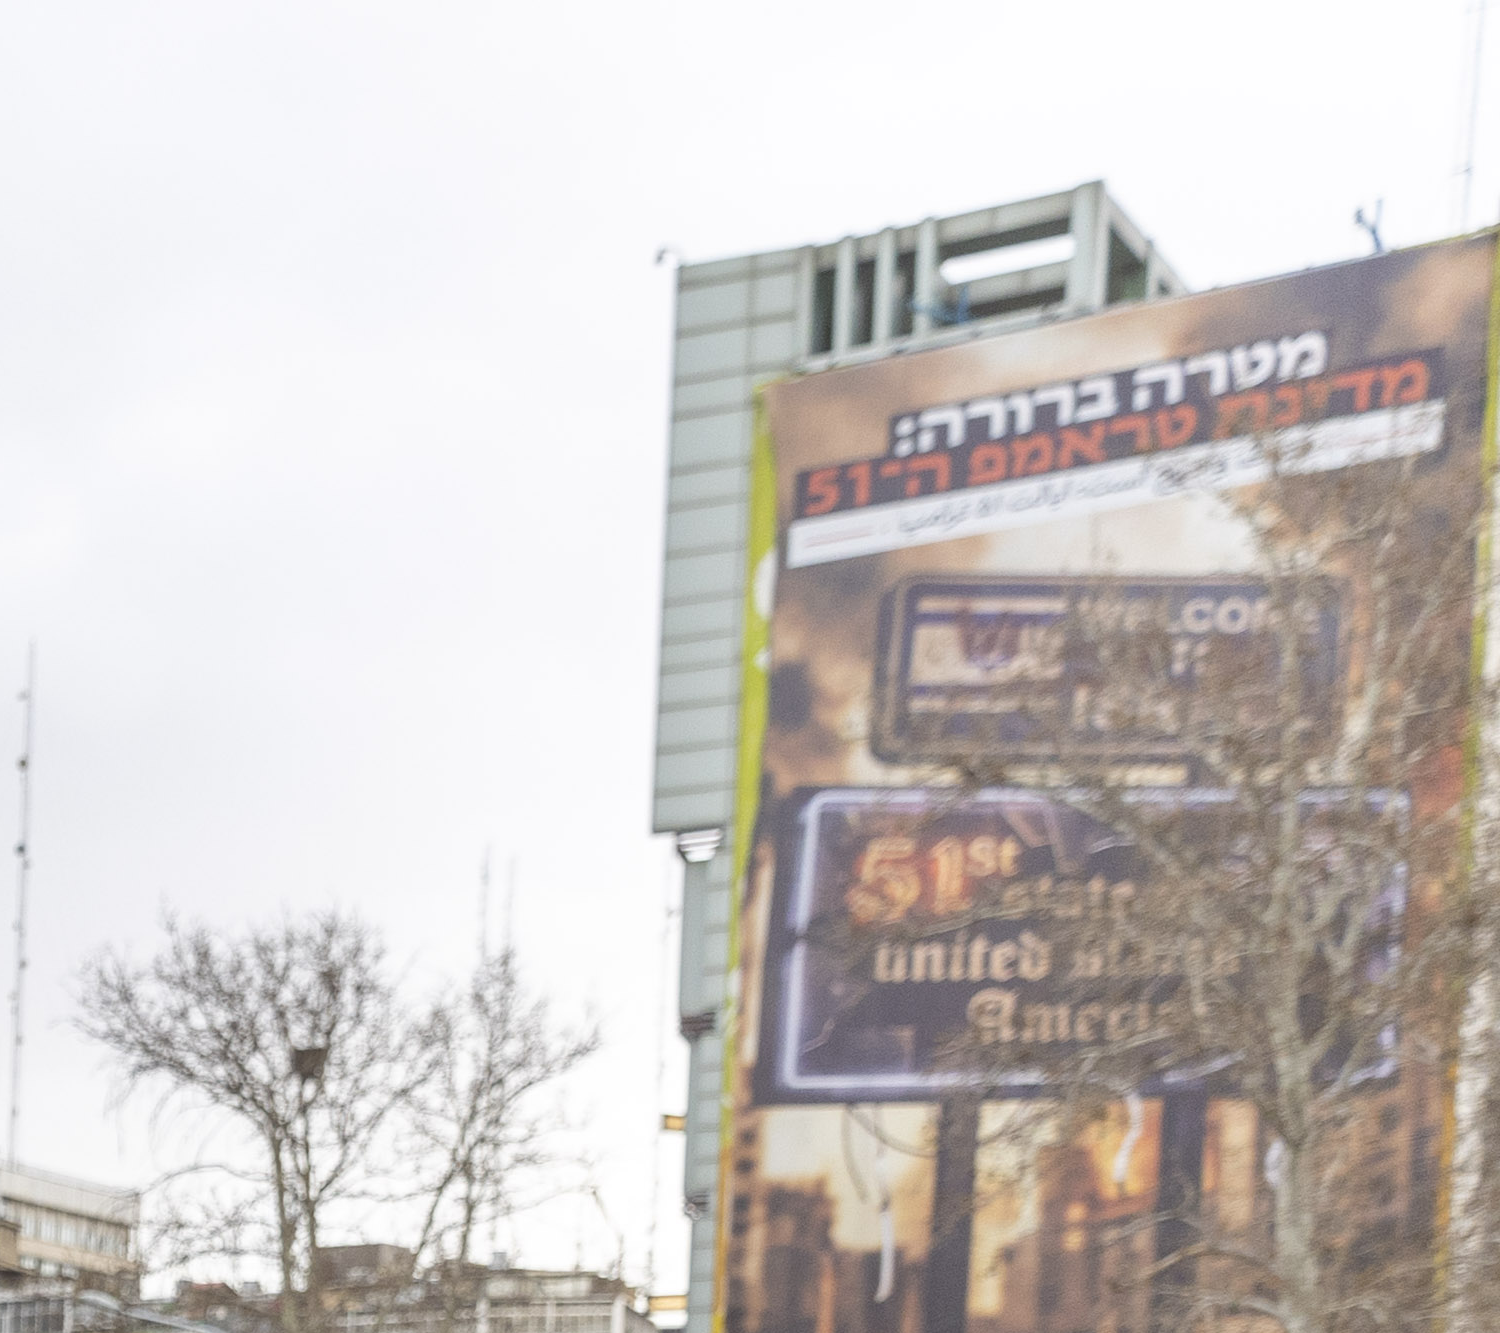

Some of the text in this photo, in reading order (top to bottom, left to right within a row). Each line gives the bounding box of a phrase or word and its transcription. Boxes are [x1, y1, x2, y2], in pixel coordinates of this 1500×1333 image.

[892, 331, 1328, 459] מטרה ברורה:
[966, 406, 1199, 488] טראמפ
[874, 930, 1053, 985] united
